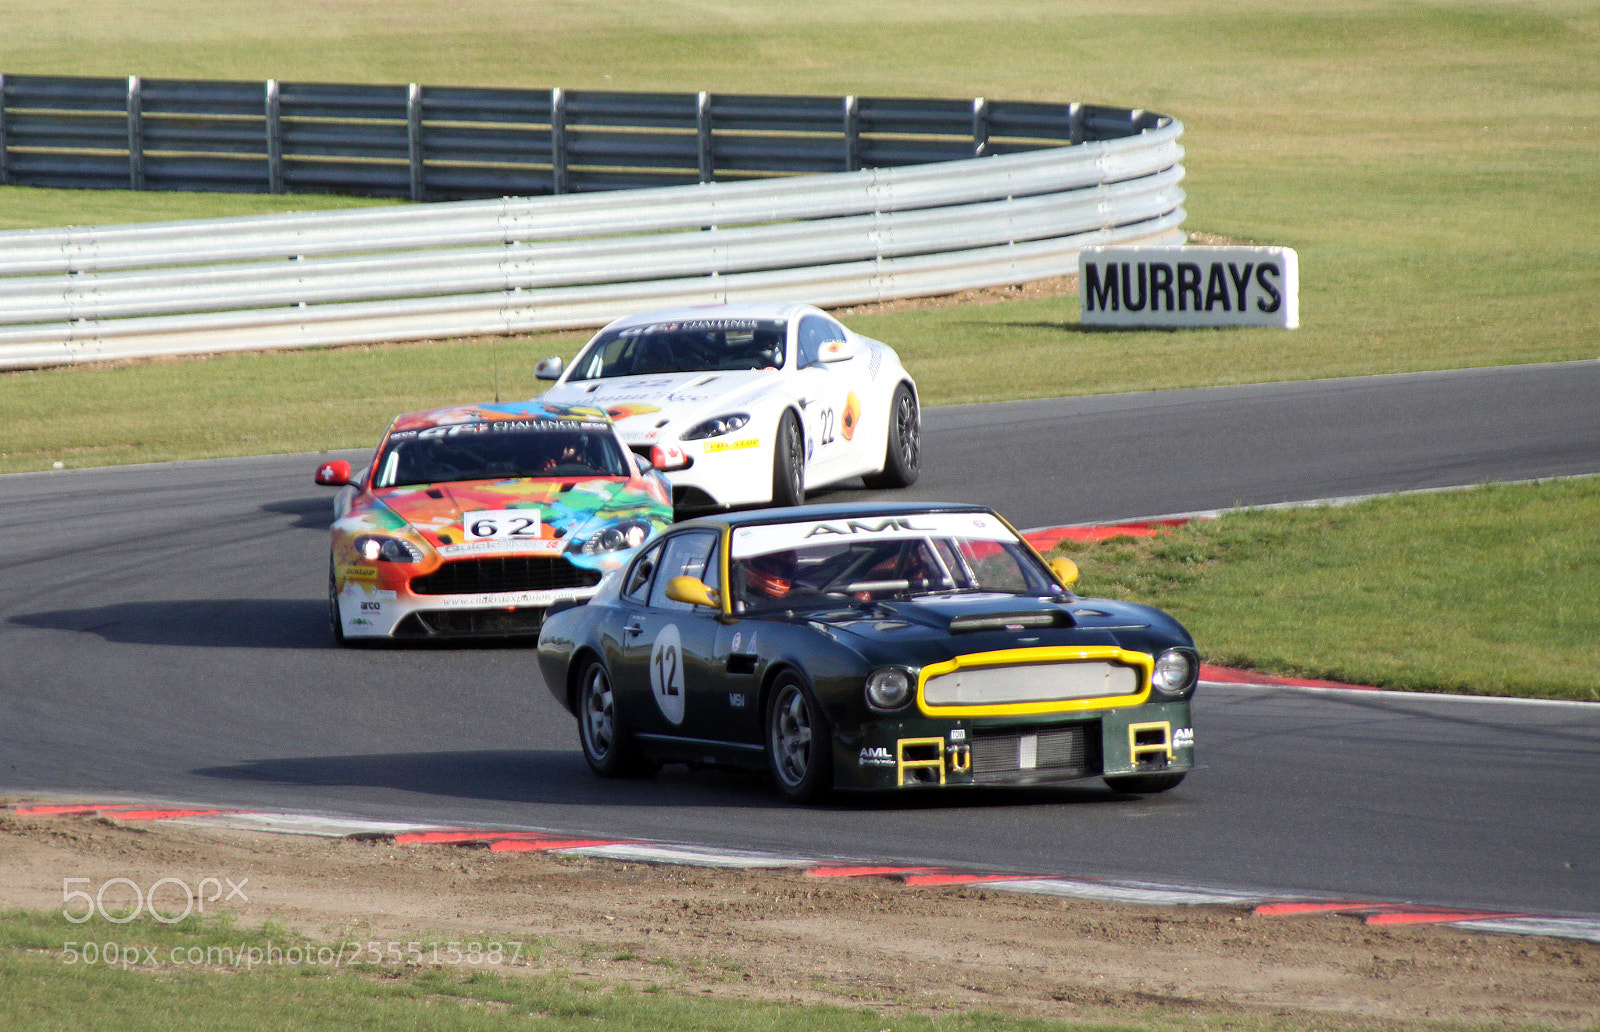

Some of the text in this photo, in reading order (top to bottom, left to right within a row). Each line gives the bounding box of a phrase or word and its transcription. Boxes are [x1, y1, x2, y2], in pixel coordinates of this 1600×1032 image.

[1085, 262, 1282, 313] MURRAYS
[390, 430, 418, 440] arco
[493, 420, 580, 431] CHALLENGE
[580, 421, 608, 429] arco
[820, 407, 835, 446] 22
[471, 518, 535, 538] 62
[804, 518, 937, 539] AML
[360, 601, 380, 610] arco
[655, 644, 679, 696] 12
[859, 747, 893, 758] AML
